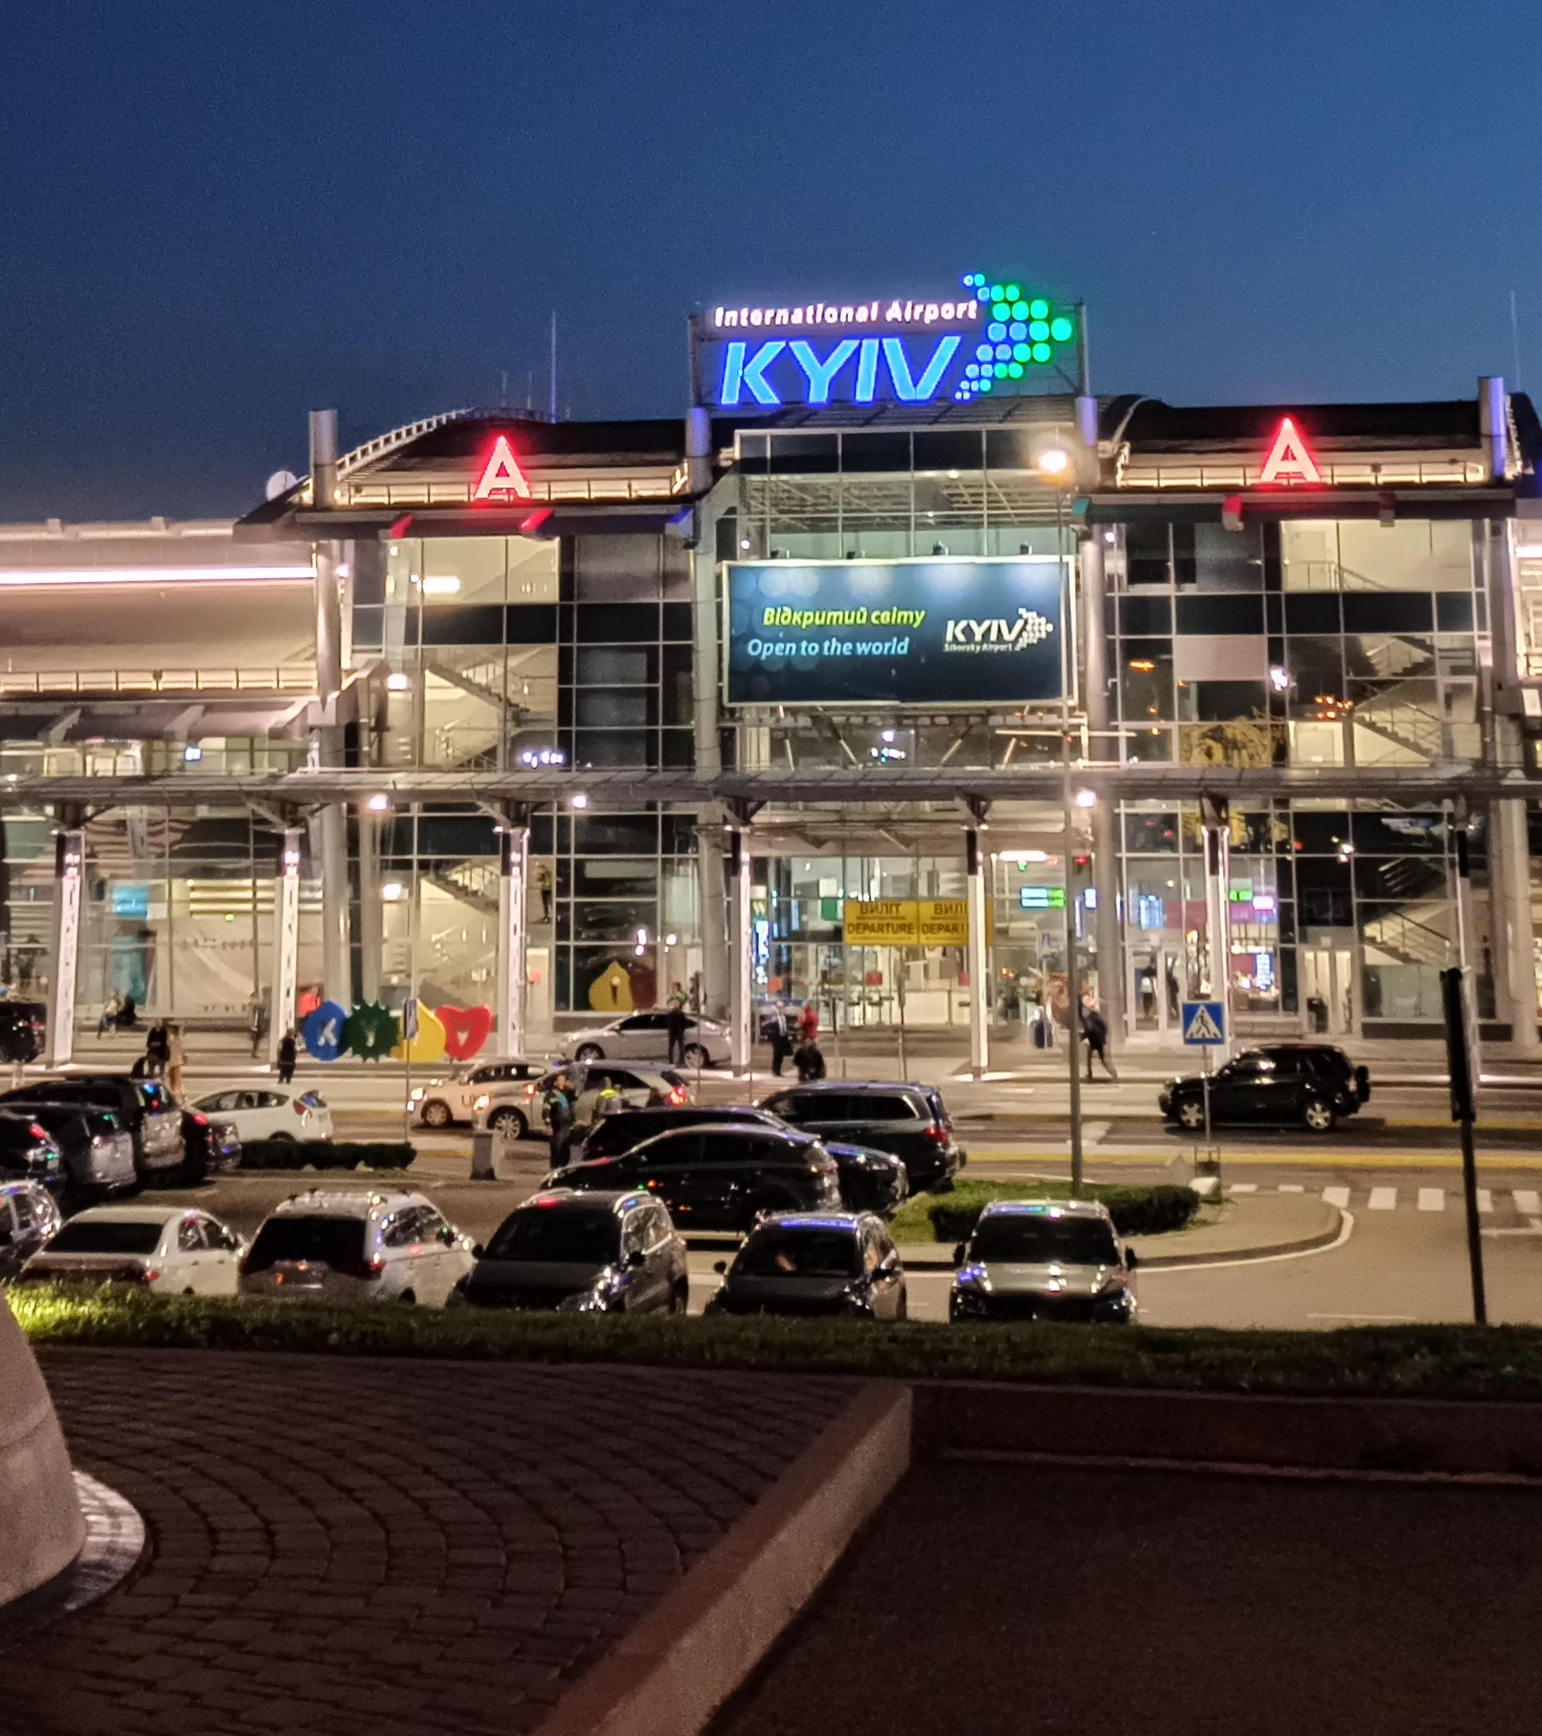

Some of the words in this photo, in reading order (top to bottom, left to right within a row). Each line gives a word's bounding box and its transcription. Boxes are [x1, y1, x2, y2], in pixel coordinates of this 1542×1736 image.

[714, 301, 879, 328] International
[885, 299, 978, 325] Airport
[720, 335, 961, 405] KYIV
[1259, 417, 1322, 483] A
[474, 434, 532, 499] A
[762, 605, 868, 630] Відкритий
[945, 618, 1026, 643] KYIV
[747, 638, 797, 661] Open
[800, 639, 820, 657] to
[822, 636, 854, 657] the
[855, 635, 910, 656] world
[859, 902, 902, 915] ВИЛІТ
[846, 922, 916, 935] DEPARTURE
